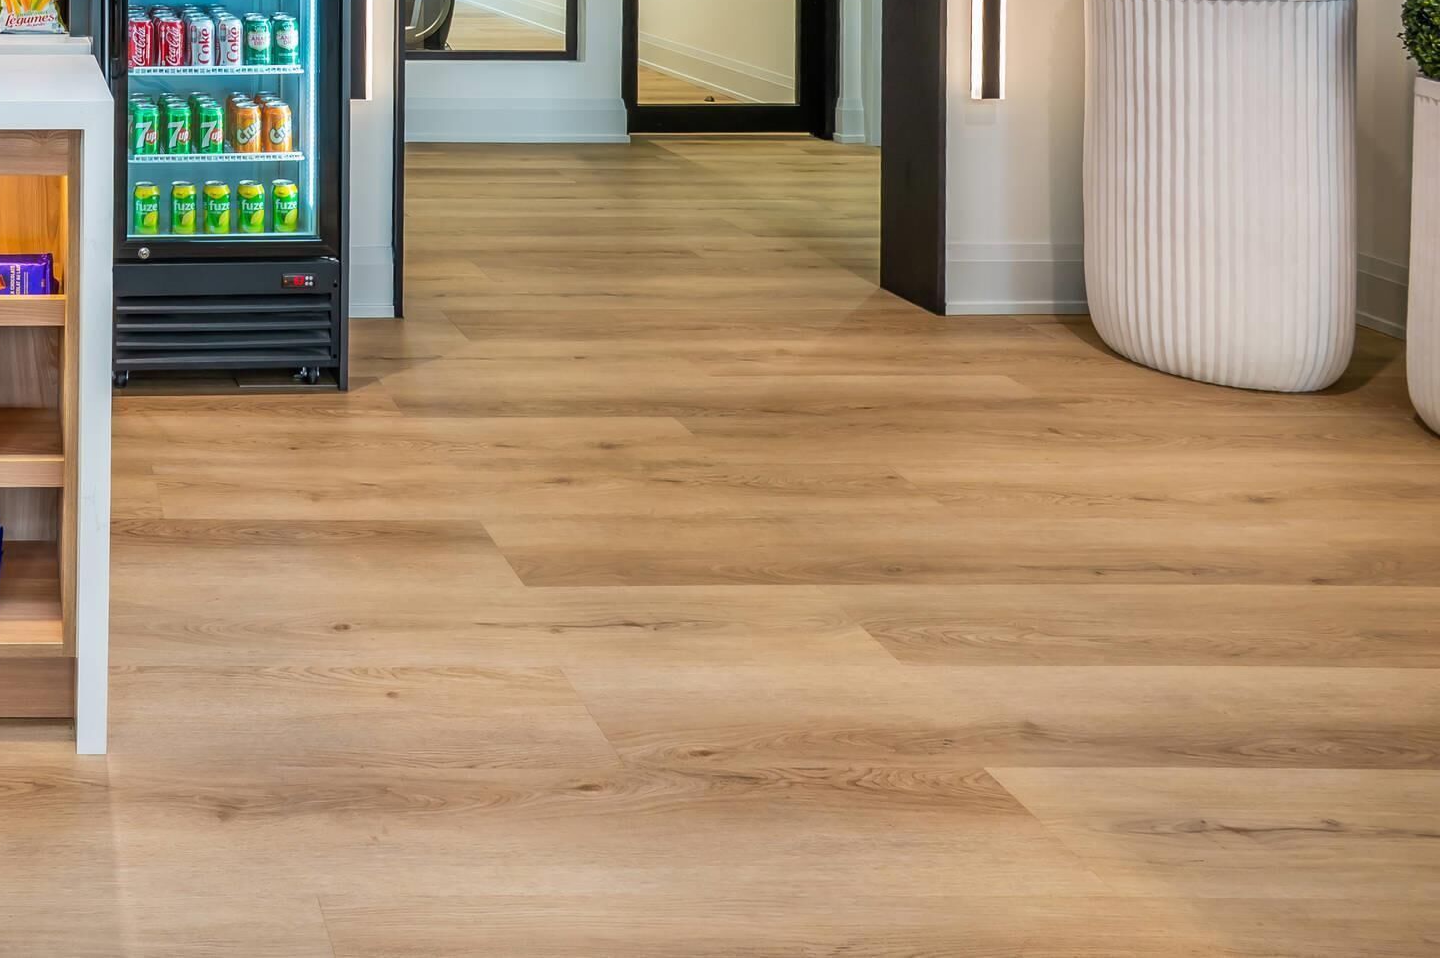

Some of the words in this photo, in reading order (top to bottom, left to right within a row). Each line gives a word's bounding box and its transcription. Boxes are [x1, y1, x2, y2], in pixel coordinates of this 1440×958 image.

[198, 28, 210, 65] Coke
[226, 26, 240, 63] Coke
[136, 199, 158, 211] fuze
[174, 199, 195, 211] fuze
[209, 199, 230, 211] fuze
[241, 199, 264, 210] fuze
[275, 198, 298, 210] fuze
